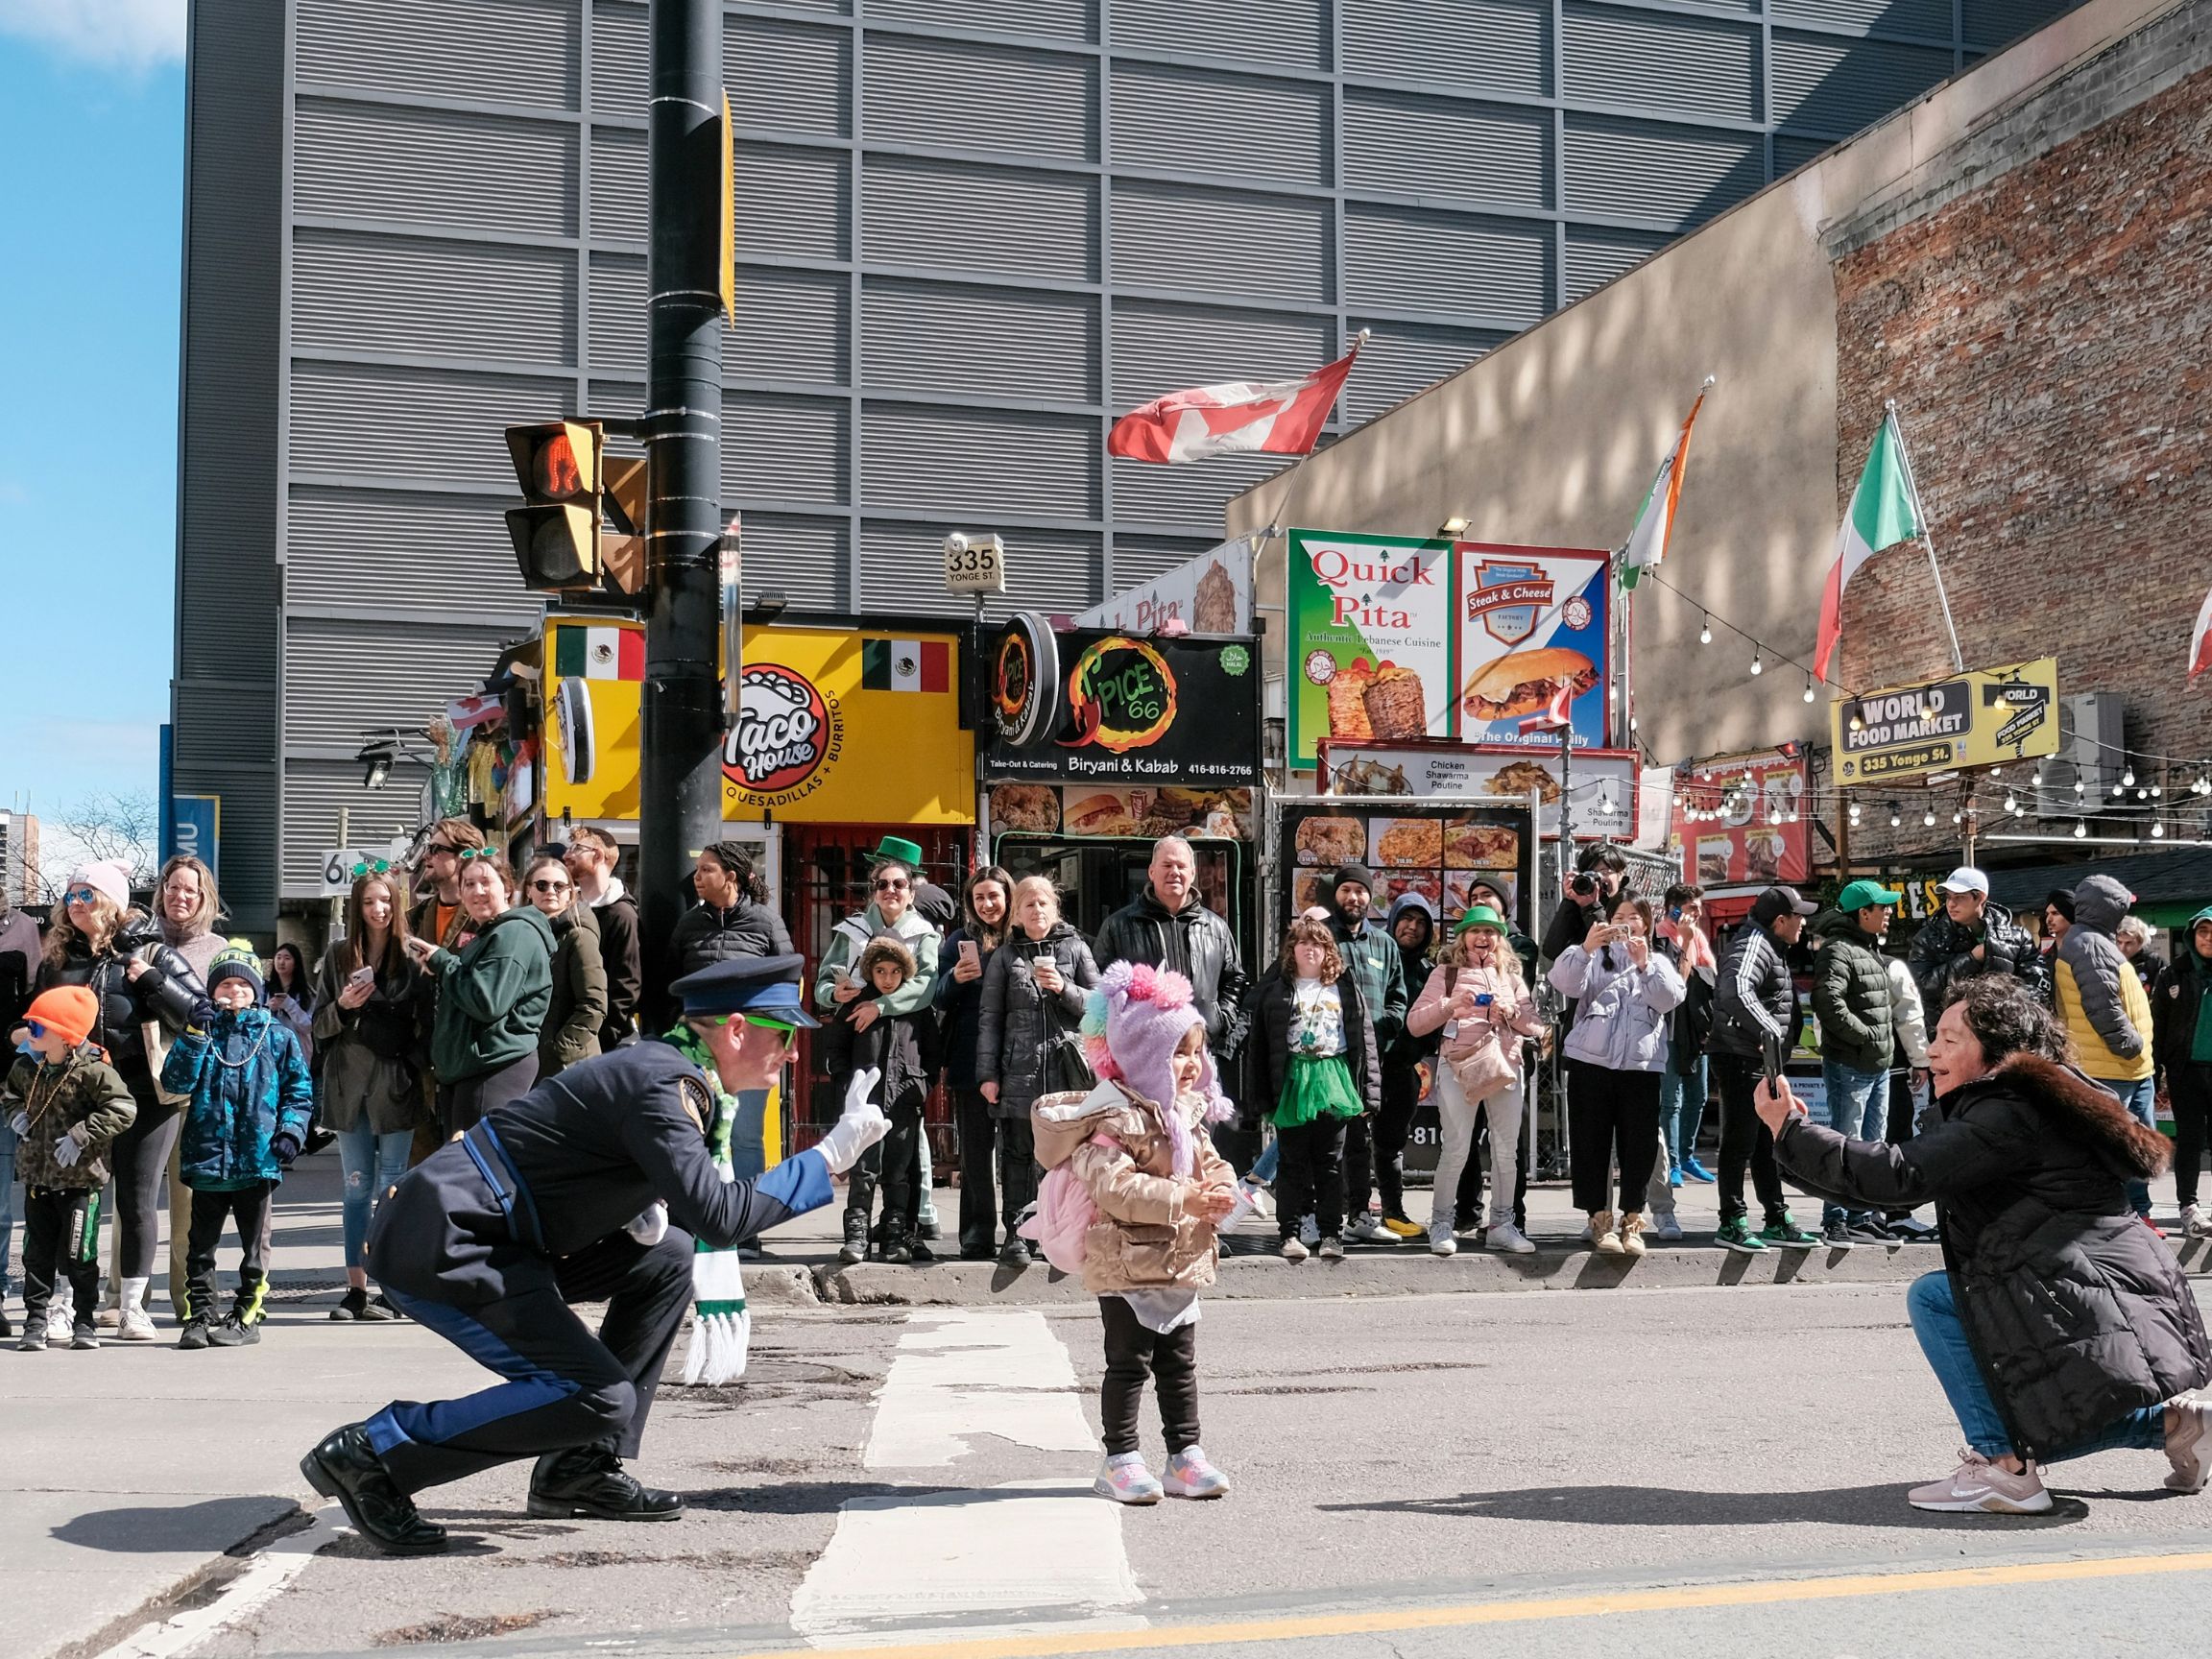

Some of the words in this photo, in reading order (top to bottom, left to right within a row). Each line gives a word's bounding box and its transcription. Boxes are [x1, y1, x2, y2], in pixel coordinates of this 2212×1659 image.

[950, 549, 994, 571] 335
[1312, 549, 1435, 588] Quick
[950, 573, 979, 582] YONGE
[1469, 590, 1499, 610] Steak
[1501, 589, 1510, 600] &
[1513, 588, 1551, 599] Cheese
[1331, 593, 1411, 629] Pita
[1306, 633, 1352, 643] Authentic
[1357, 634, 1402, 646] Lebanese
[1405, 637, 1441, 648] Cuisine
[995, 707, 1015, 736] Biryani
[1020, 681, 1034, 727] Kabab
[1128, 701, 1160, 719] 66
[1863, 690, 1945, 725] WORLD
[1848, 727, 1890, 748] FOOD
[1893, 713, 1962, 741] MARKET
[1997, 724, 2016, 739] FOOD
[2017, 707, 2043, 727] MARKET
[726, 708, 817, 764] Taco
[1504, 733, 1552, 745] Original
[1555, 733, 1589, 747] Pilly
[726, 775, 823, 807] QUESADILLAS
[824, 689, 844, 762] BURRITOS
[743, 743, 814, 781] House
[1029, 760, 1058, 770] Catering
[1069, 757, 1118, 775] Biryani
[1121, 758, 1133, 771] &
[1136, 759, 1179, 774] Kabab
[1189, 764, 1252, 775] 416-816-2766
[1431, 761, 1465, 770] Chicken
[1863, 756, 1887, 772] 335
[1889, 753, 1928, 767] Yonge
[1932, 748, 1949, 761] St.
[1426, 771, 1469, 780] Shawarma
[1431, 781, 1463, 790] Poutine
[1593, 819, 1623, 828] Poutine
